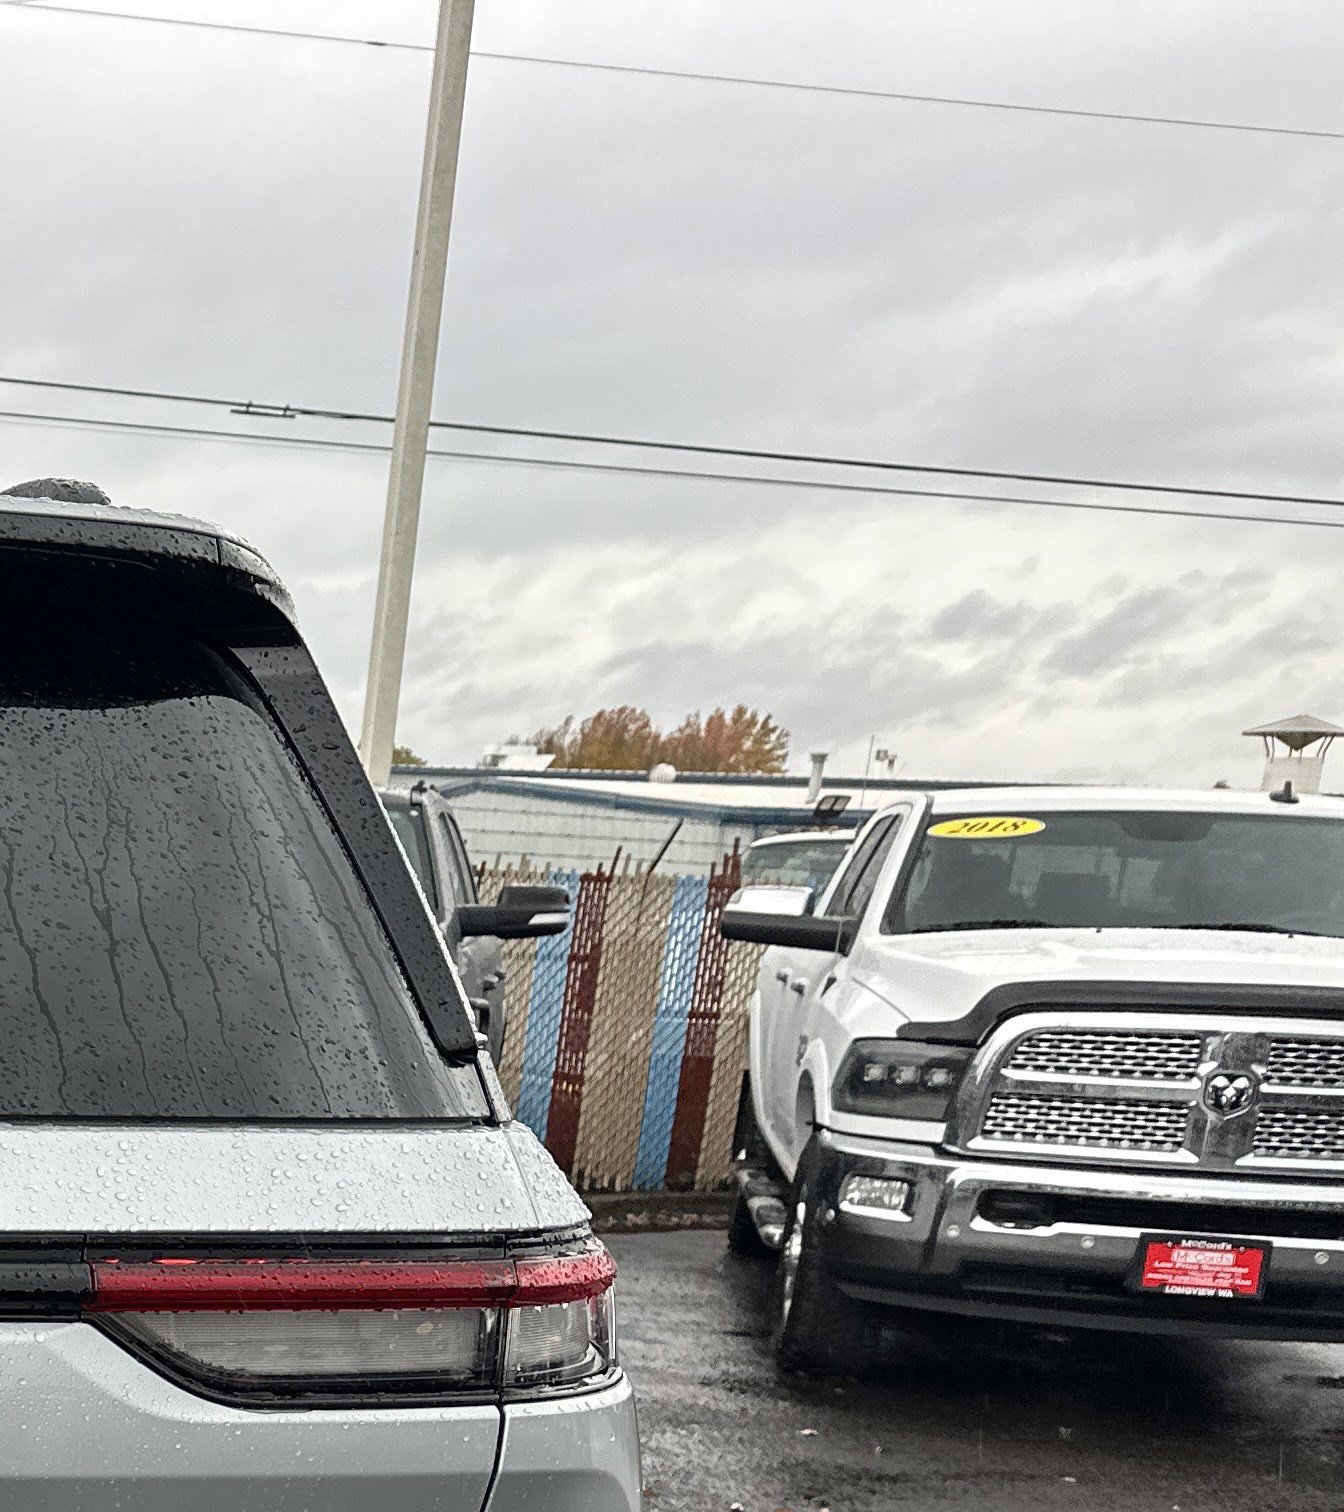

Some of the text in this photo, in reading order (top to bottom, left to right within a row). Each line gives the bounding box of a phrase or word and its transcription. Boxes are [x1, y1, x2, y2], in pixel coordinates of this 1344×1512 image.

[946, 820, 1028, 834] 2018
[1164, 1285, 1233, 1298] LONGVIEW WA
